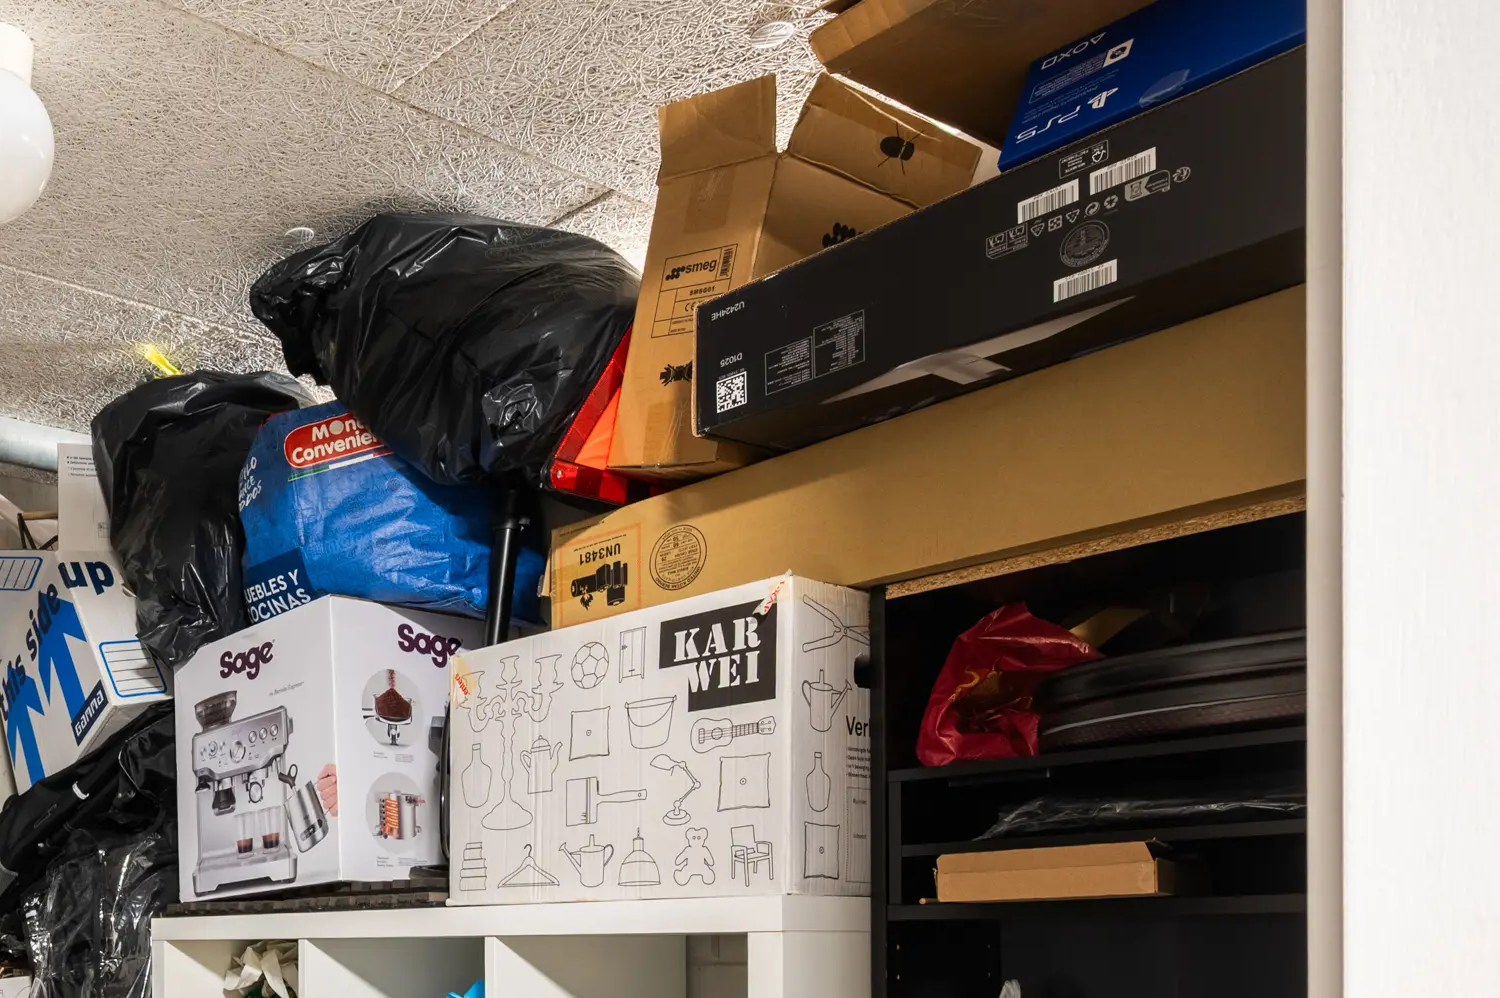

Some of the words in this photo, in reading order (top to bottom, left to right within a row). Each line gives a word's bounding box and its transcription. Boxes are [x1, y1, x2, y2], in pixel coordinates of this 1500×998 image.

[1015, 105, 1081, 144] PS5
[685, 259, 718, 274] smeg
[711, 301, 746, 321] U2424HE
[720, 352, 744, 368] D1025
[578, 541, 622, 565] UN3481
[58, 561, 115, 595] up
[288, 568, 300, 587] Y
[26, 583, 60, 661] side
[674, 616, 761, 661] KAR
[219, 640, 275, 681] Sage
[397, 623, 463, 669] Sage
[688, 651, 759, 693] WEI
